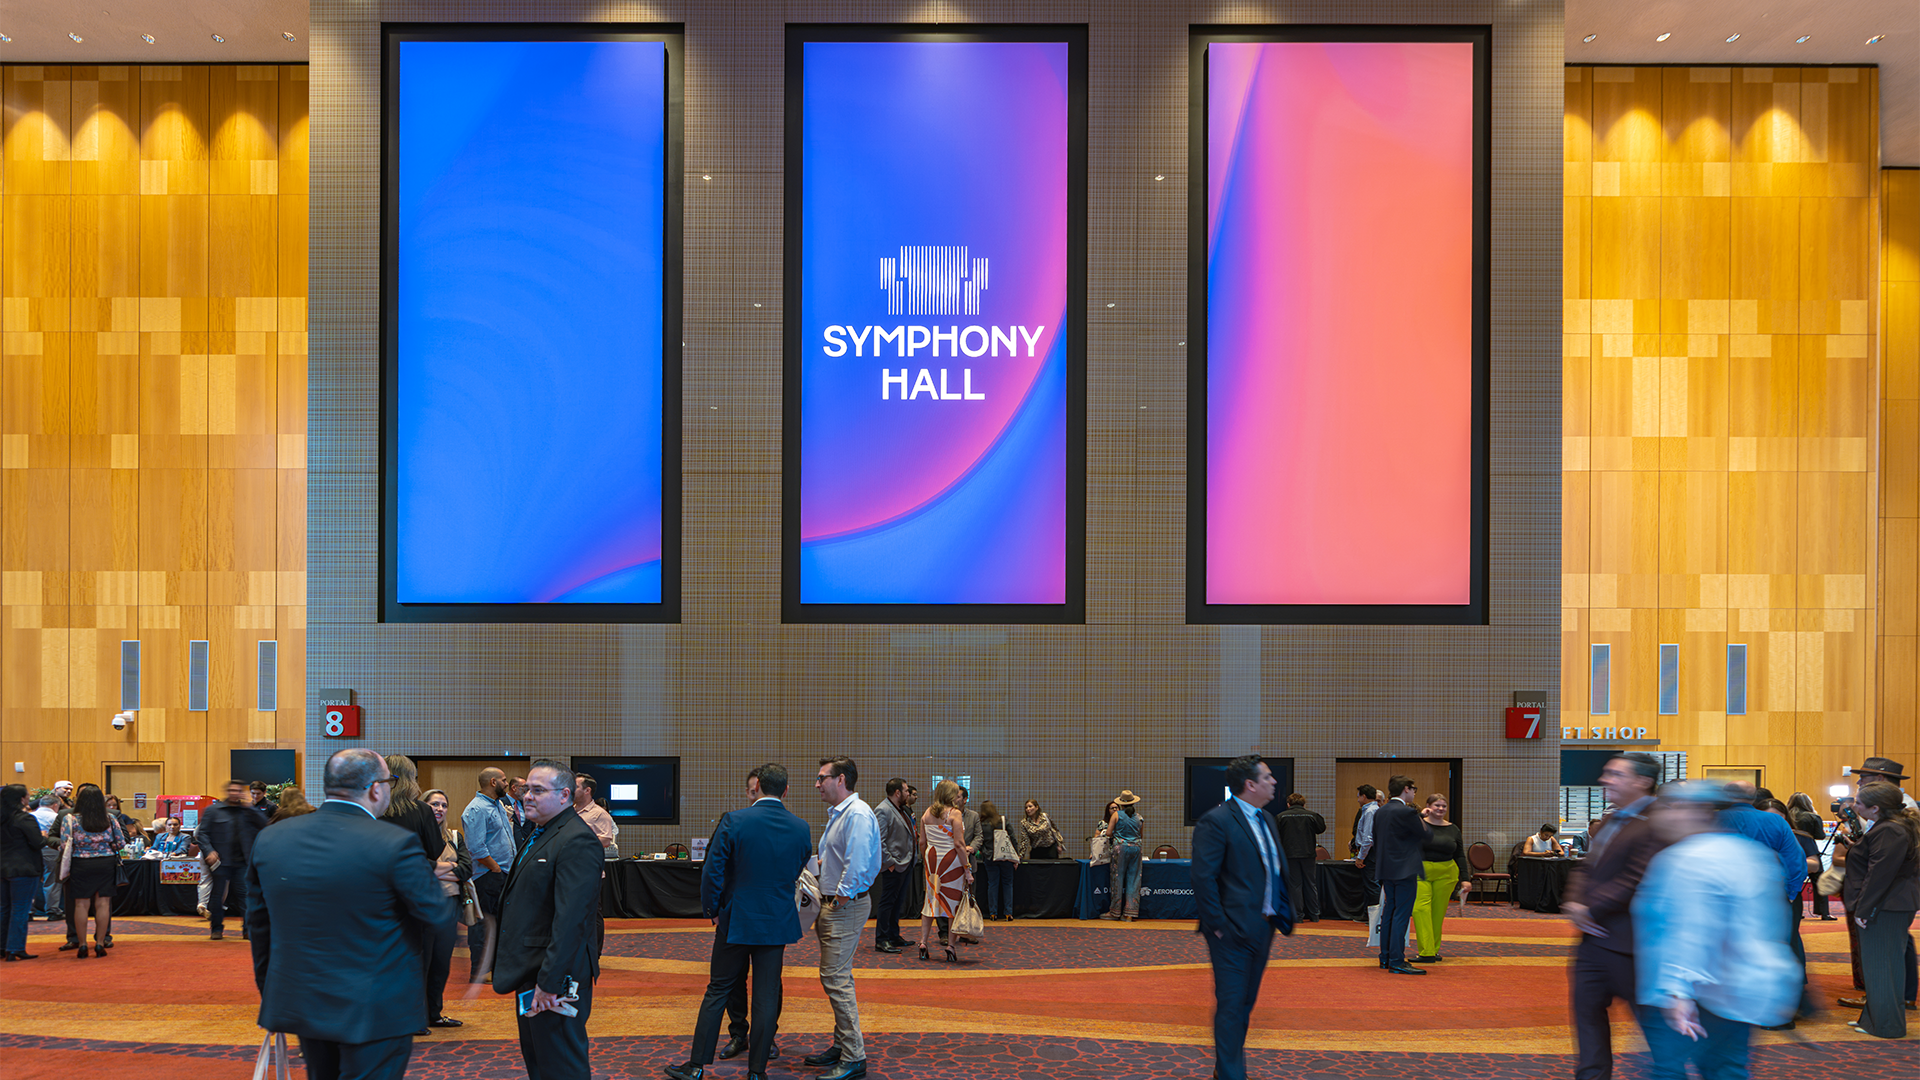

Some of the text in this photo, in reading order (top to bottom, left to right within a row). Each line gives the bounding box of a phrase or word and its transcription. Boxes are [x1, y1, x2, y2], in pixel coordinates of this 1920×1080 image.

[822, 324, 1045, 358] SYMPHONY
[882, 368, 986, 400] HALL
[325, 710, 344, 737] 8
[1523, 713, 1541, 739] 7
[1561, 726, 1647, 740] FT SHOP
